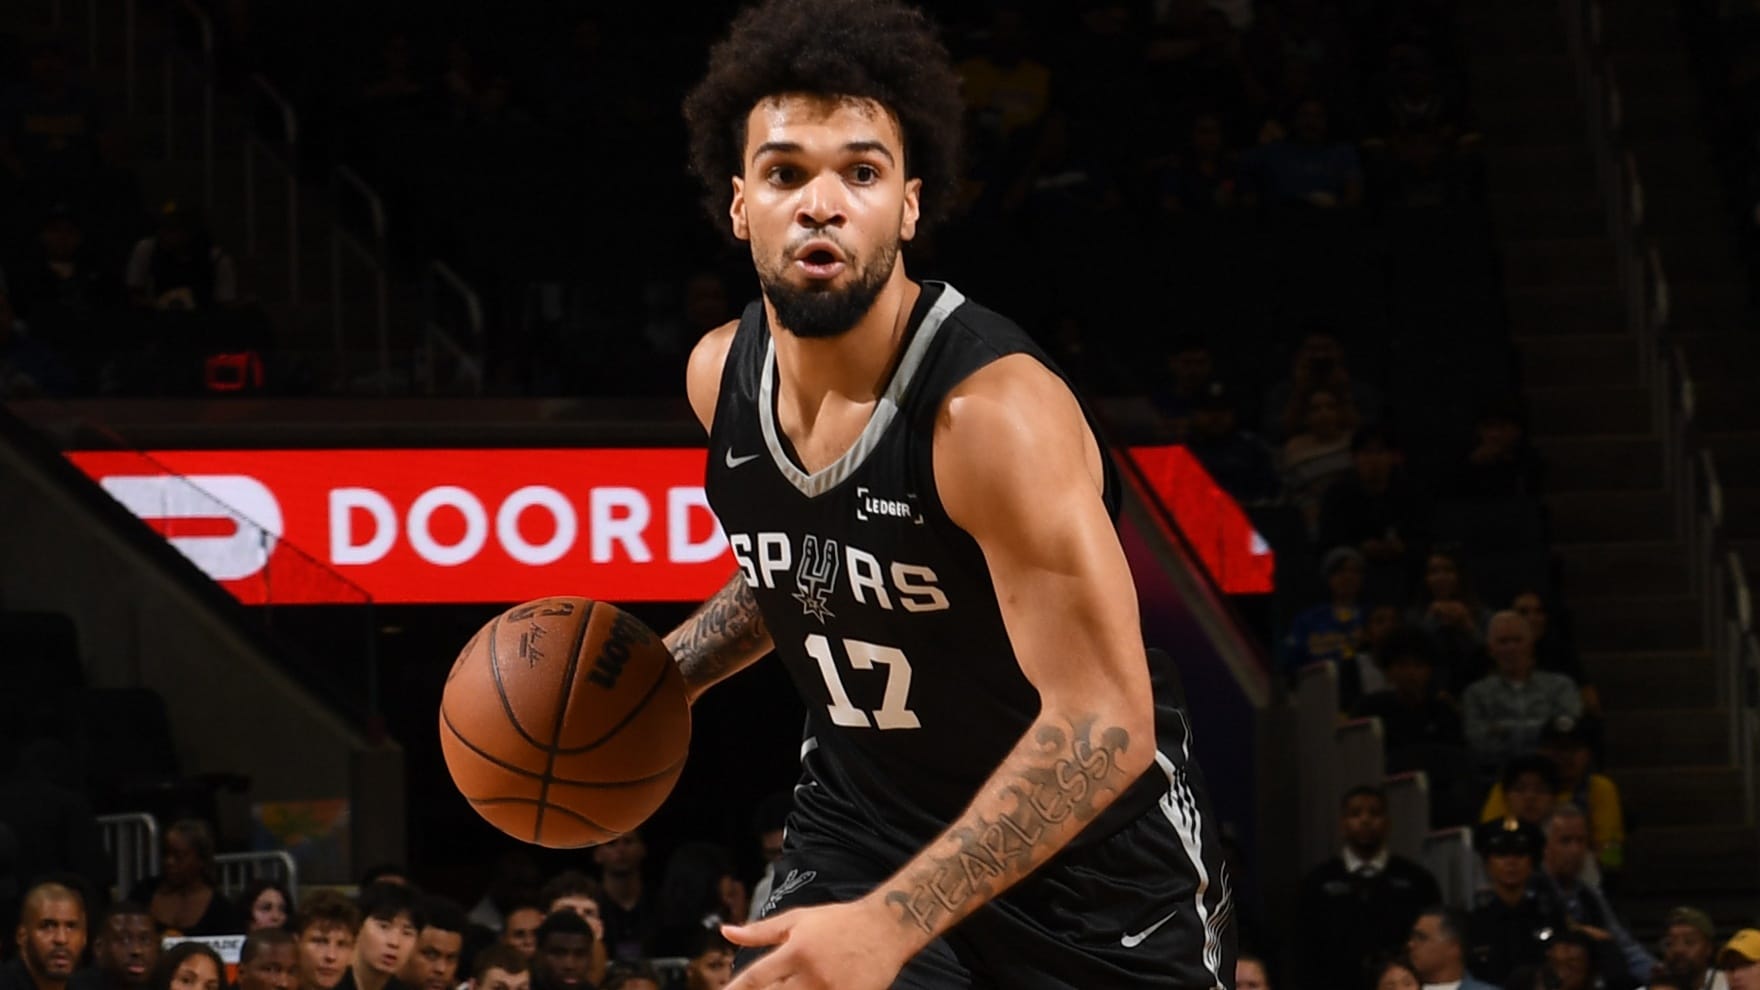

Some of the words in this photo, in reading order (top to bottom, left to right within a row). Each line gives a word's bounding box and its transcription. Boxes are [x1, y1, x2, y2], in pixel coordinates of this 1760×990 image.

[865, 496, 911, 518] LEDGER
[804, 633, 921, 730] 17
[902, 739, 1109, 934] FEARLESS
